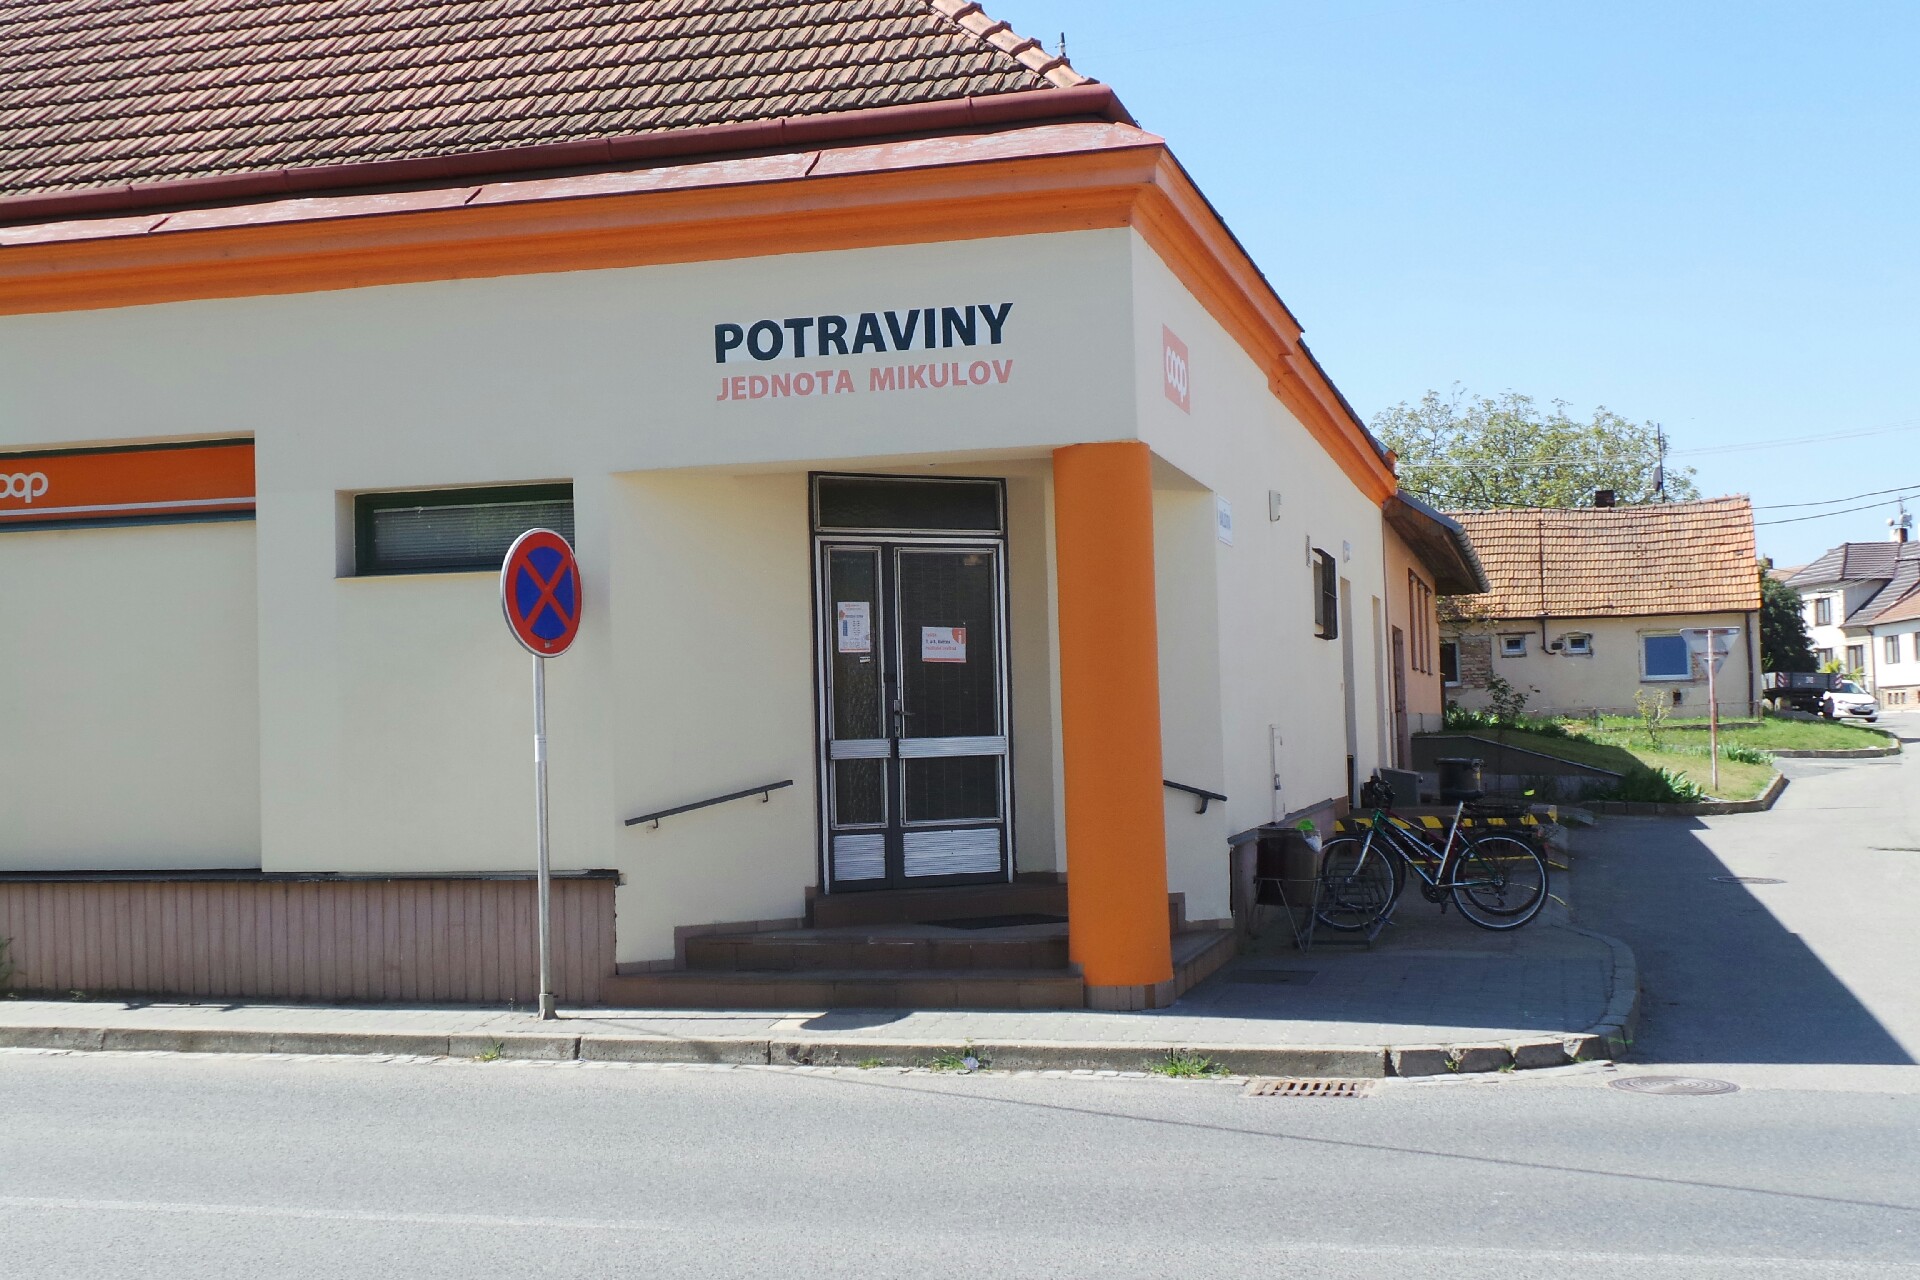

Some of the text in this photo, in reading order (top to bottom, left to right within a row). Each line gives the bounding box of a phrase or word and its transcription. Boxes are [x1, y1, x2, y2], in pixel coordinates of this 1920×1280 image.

[714, 303, 1014, 364] POTRAVINY
[716, 359, 1014, 402] JEDNOTA MIKULOV
[1166, 346, 1187, 403] coop
